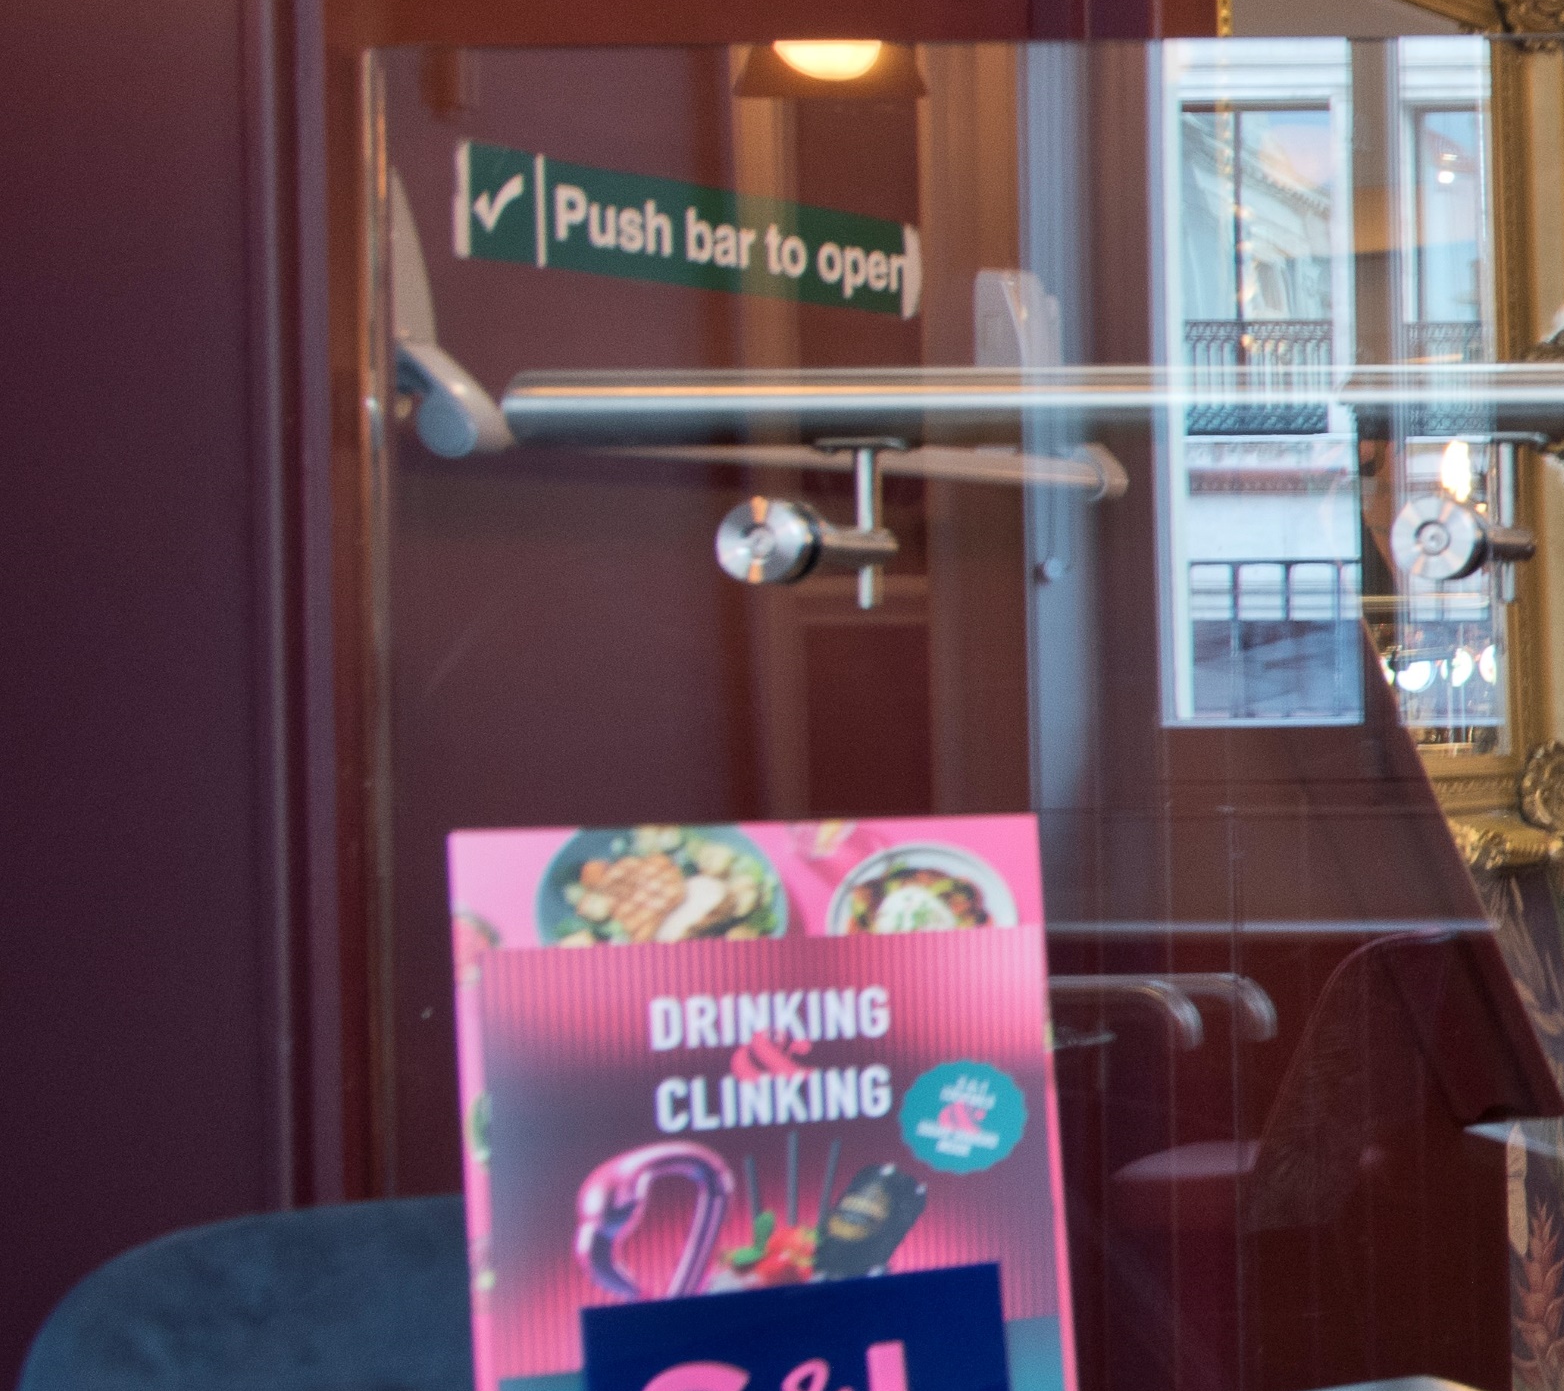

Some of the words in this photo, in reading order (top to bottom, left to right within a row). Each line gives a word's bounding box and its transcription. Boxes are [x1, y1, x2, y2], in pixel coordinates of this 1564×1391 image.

[555, 183, 673, 258] Push
[685, 206, 756, 270] bar
[765, 223, 808, 278] to
[649, 985, 891, 1051] DRINKING
[656, 1064, 892, 1133] CLINKING
